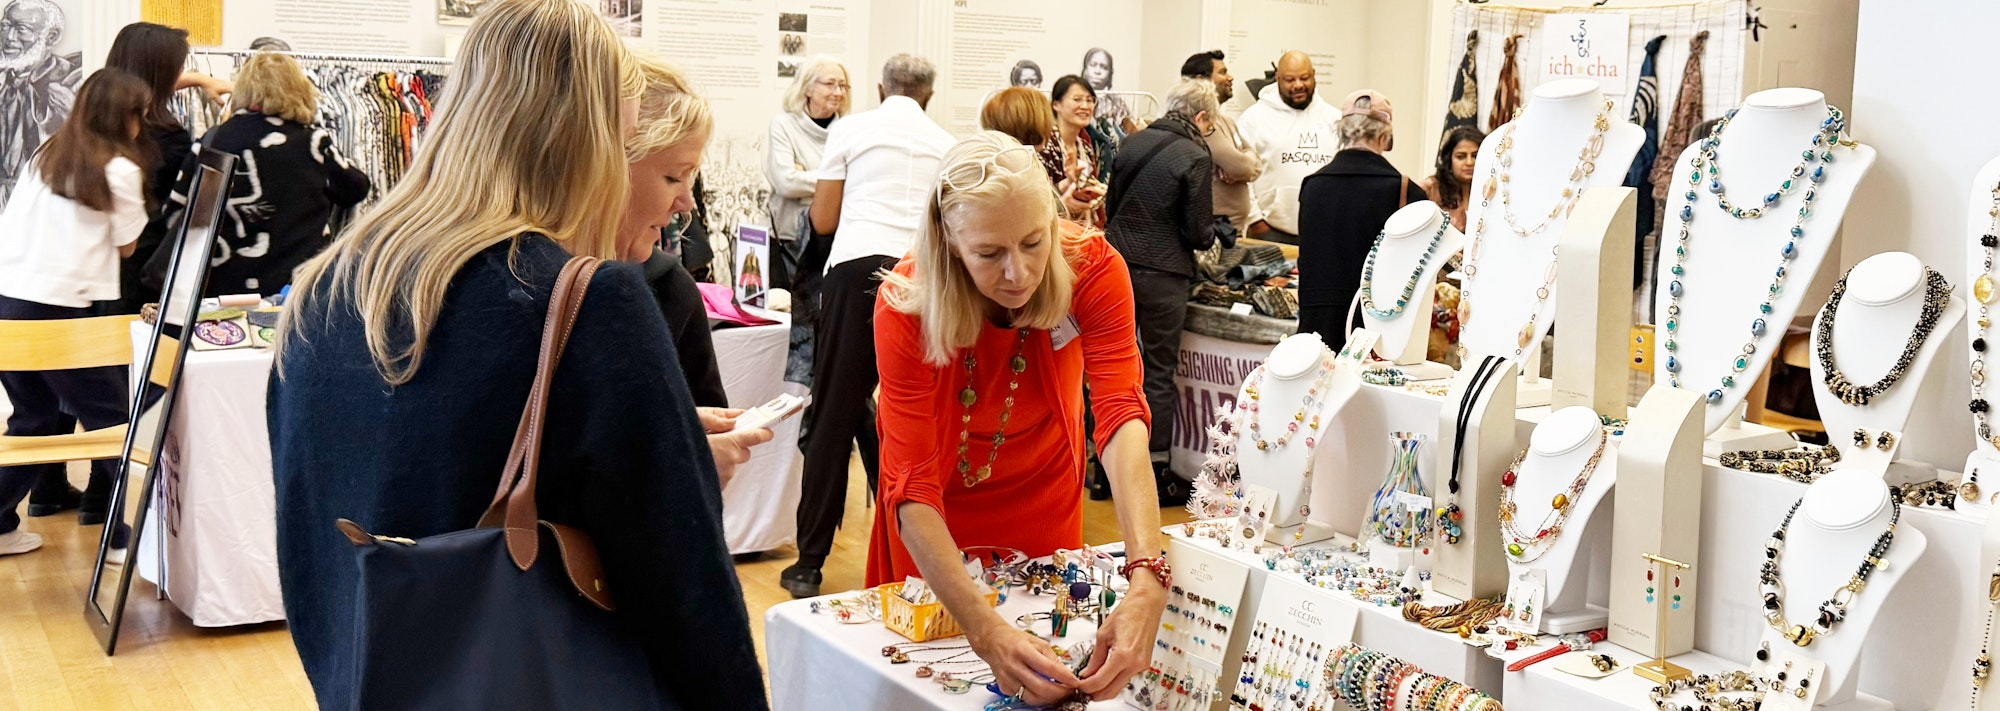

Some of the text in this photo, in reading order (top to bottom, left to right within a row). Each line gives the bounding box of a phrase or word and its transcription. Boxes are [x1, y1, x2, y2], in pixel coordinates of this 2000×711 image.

[1549, 55, 1617, 77] ich cha
[1281, 152, 1332, 165] BASQUIAT
[1288, 607, 1323, 626] ZECCHIN
